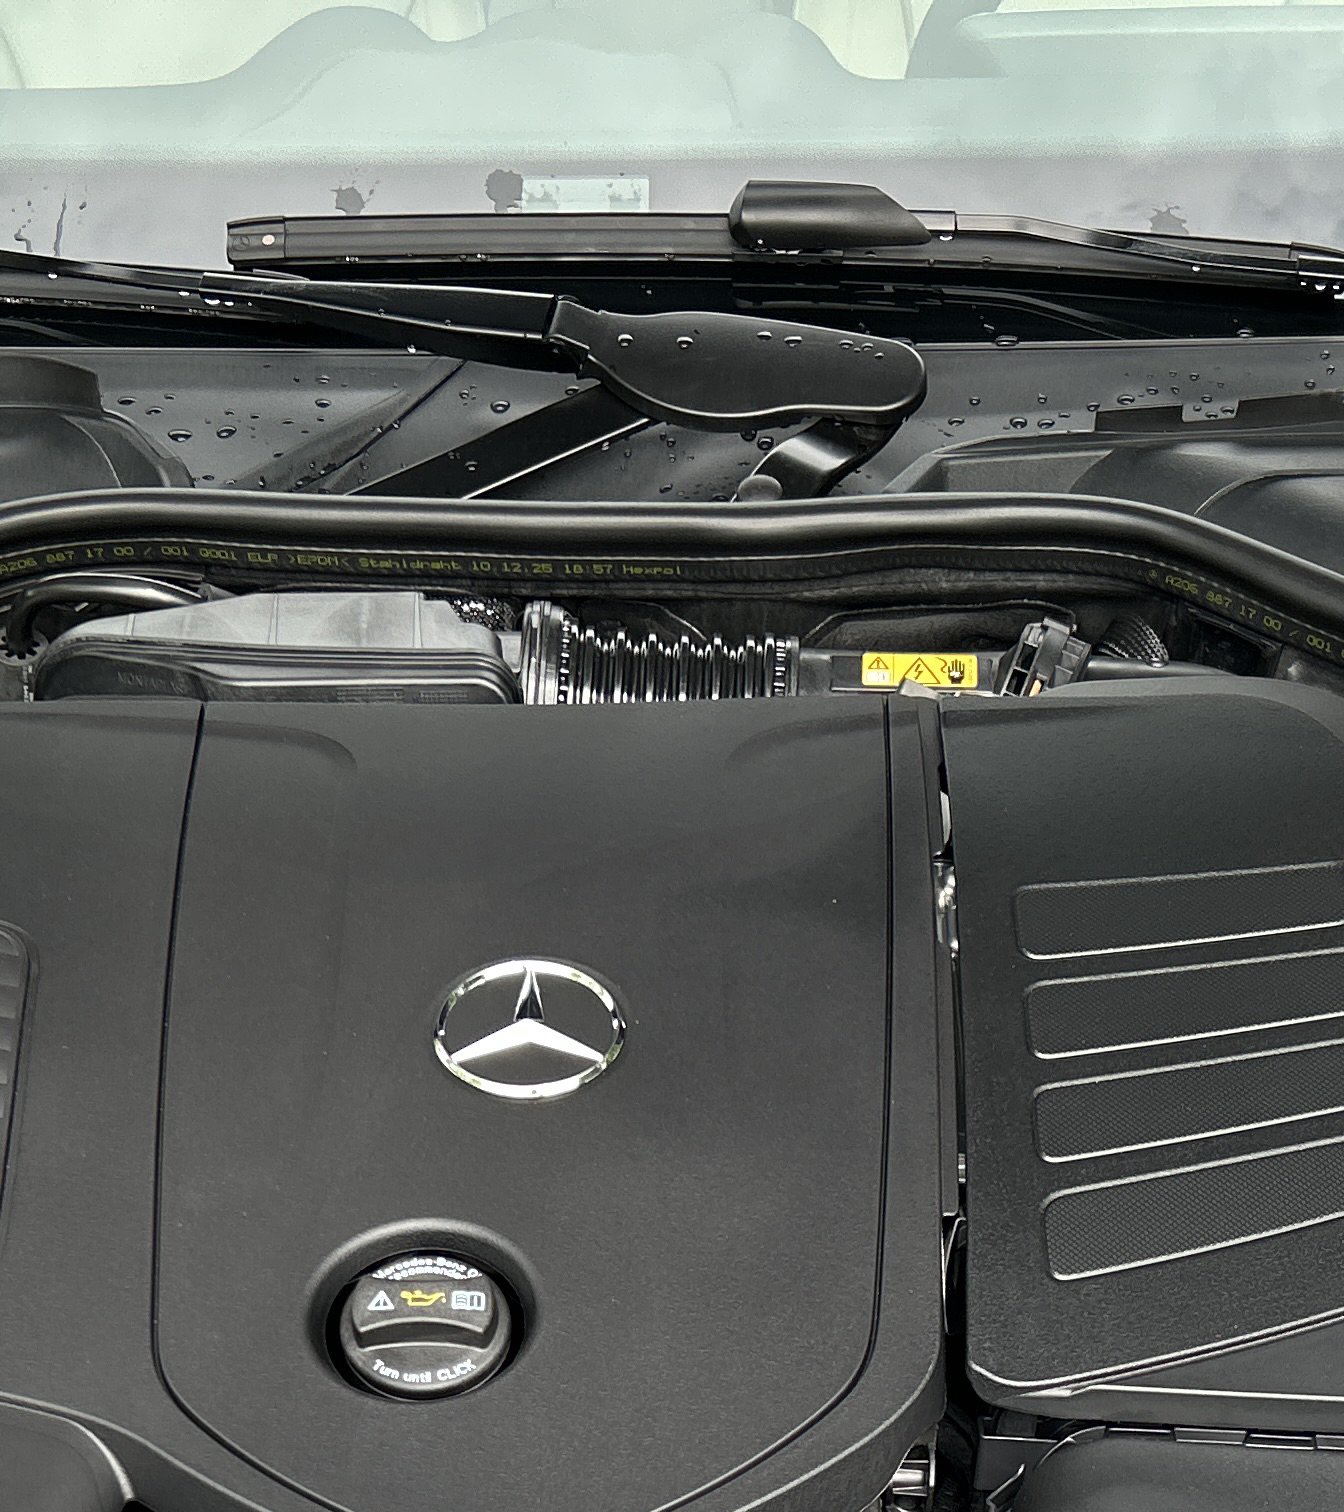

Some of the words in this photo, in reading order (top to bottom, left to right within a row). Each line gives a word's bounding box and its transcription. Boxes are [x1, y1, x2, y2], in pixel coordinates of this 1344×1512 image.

[372, 1359, 400, 1380] Turn
[403, 1369, 432, 1384] until
[437, 1359, 476, 1382] CLICK
